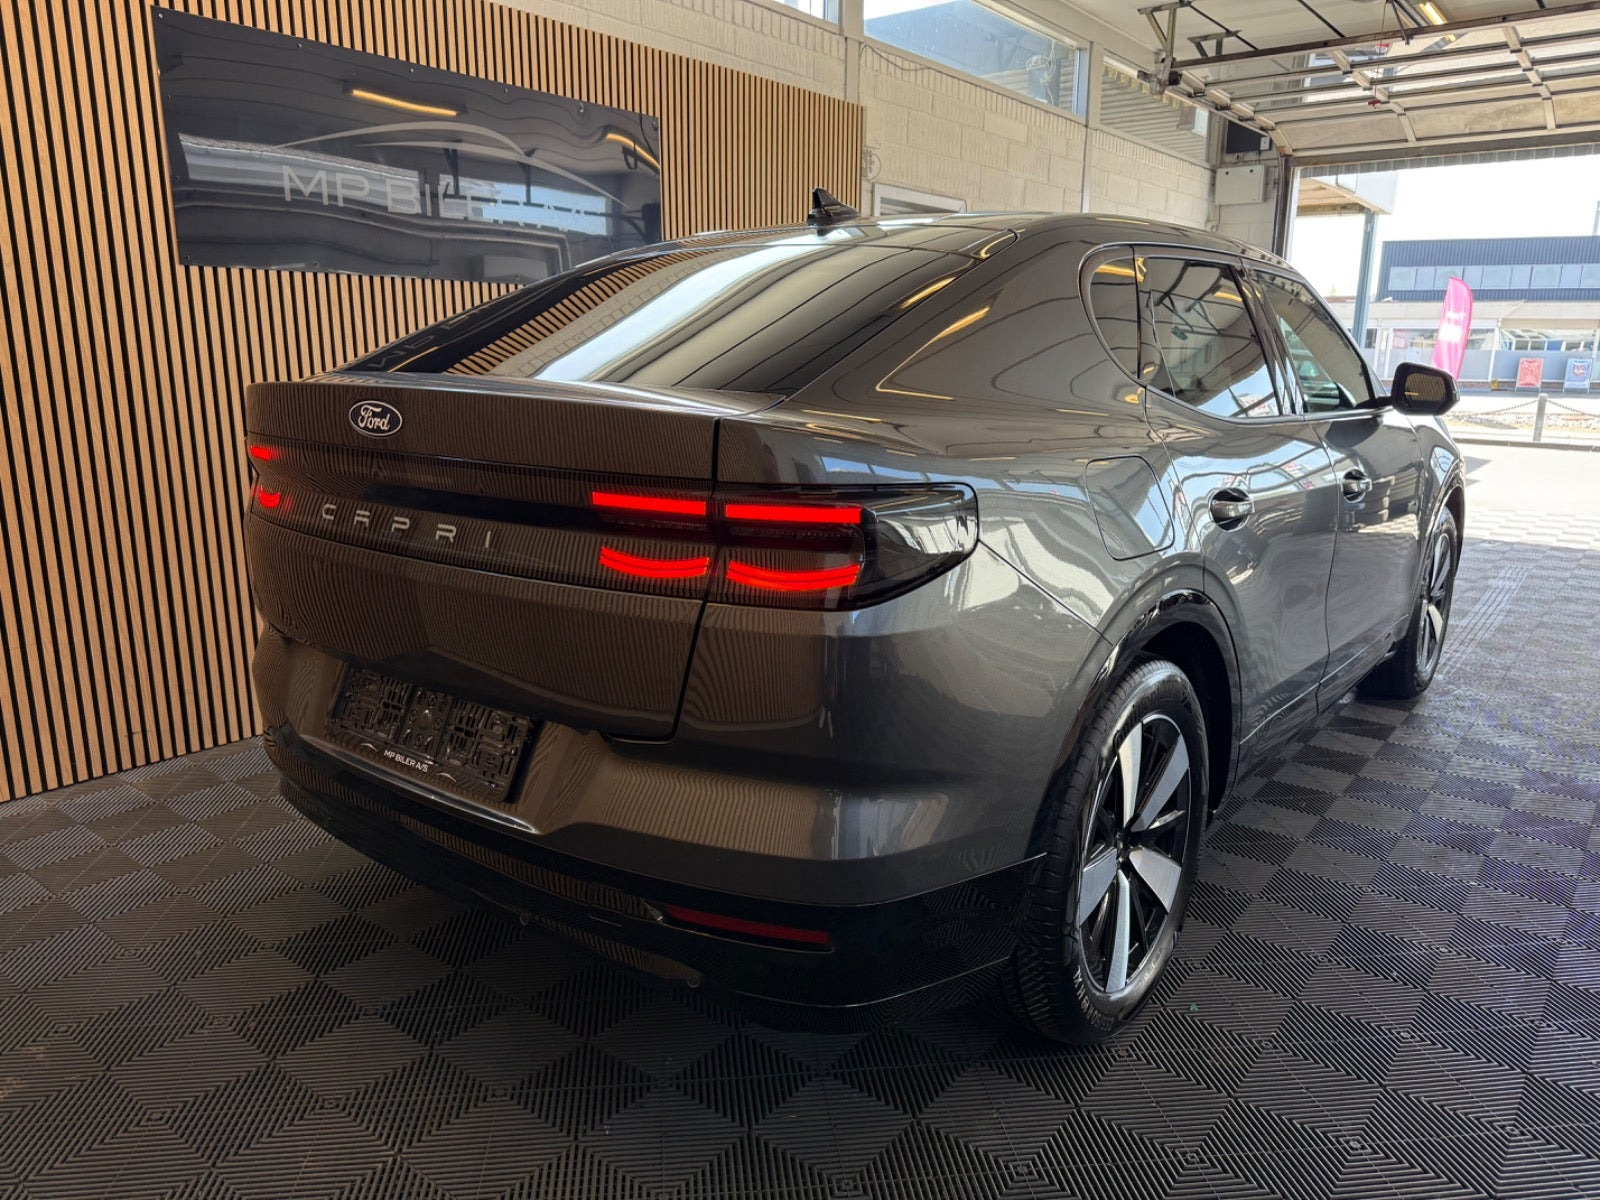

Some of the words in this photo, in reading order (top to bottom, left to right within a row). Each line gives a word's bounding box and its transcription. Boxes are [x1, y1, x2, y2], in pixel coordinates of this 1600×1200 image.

[282, 165, 370, 208] MP
[358, 404, 391, 431] Ford
[322, 503, 491, 548] CAPRI
[384, 750, 395, 759] MP
[395, 753, 415, 767] BILER
[416, 762, 429, 773] A/S
